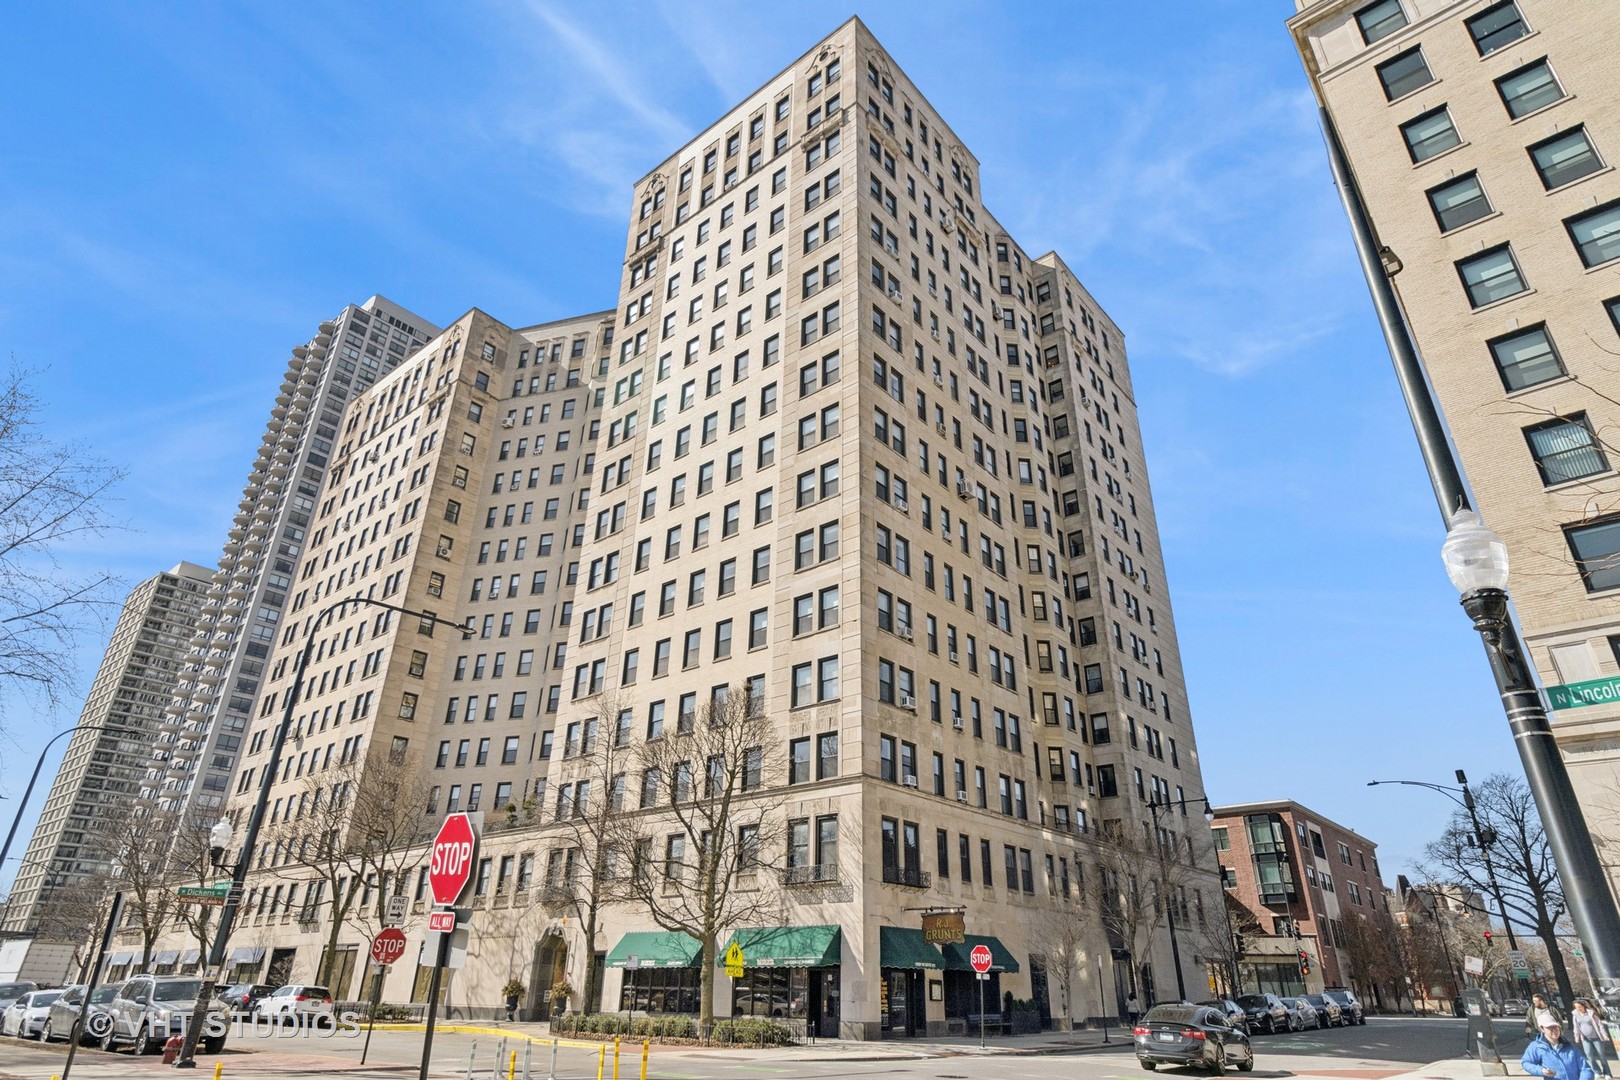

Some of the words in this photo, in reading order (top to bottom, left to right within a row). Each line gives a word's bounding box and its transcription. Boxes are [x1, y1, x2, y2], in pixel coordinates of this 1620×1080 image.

[1556, 694, 1567, 704] N
[432, 842, 470, 875] STOP
[187, 888, 215, 896] Dickens
[431, 917, 441, 928] ALL
[442, 917, 453, 928] WAY
[926, 929, 962, 940] GRUNTS
[374, 939, 404, 953] STOP
[972, 953, 990, 965] STOP
[1512, 960, 1526, 968] 20
